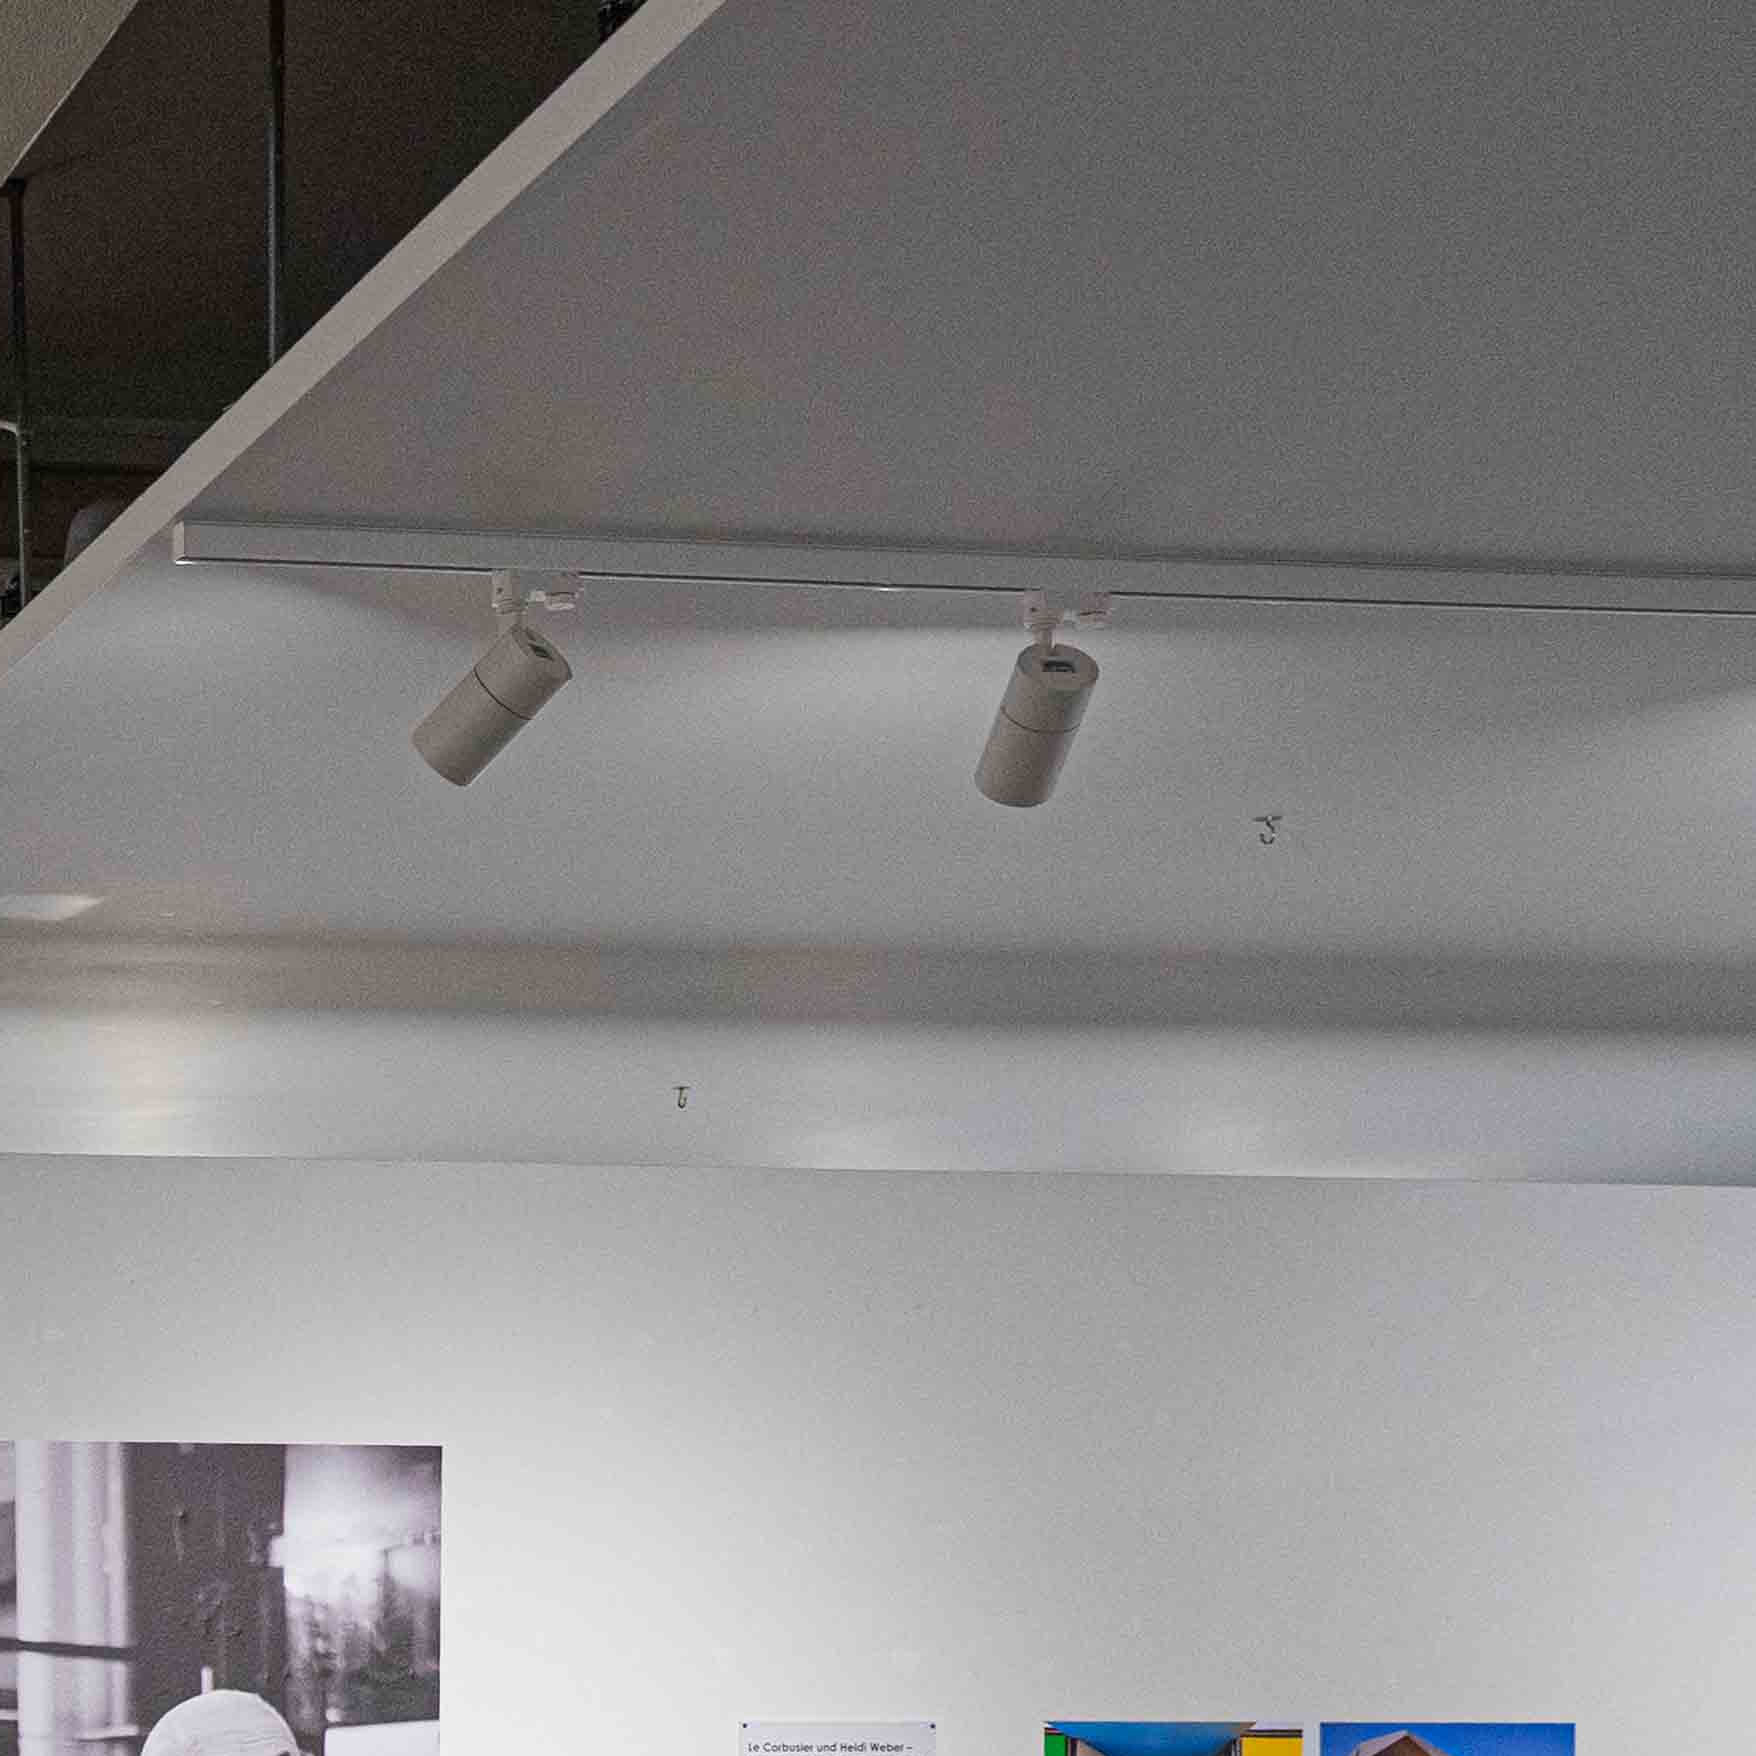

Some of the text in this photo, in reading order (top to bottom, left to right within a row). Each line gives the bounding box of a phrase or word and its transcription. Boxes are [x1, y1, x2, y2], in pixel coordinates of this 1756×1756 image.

[763, 1742, 814, 1753] Corbusier
[817, 1743, 837, 1753] und
[840, 1743, 868, 1753] Heidi
[870, 1743, 904, 1753] Weber
